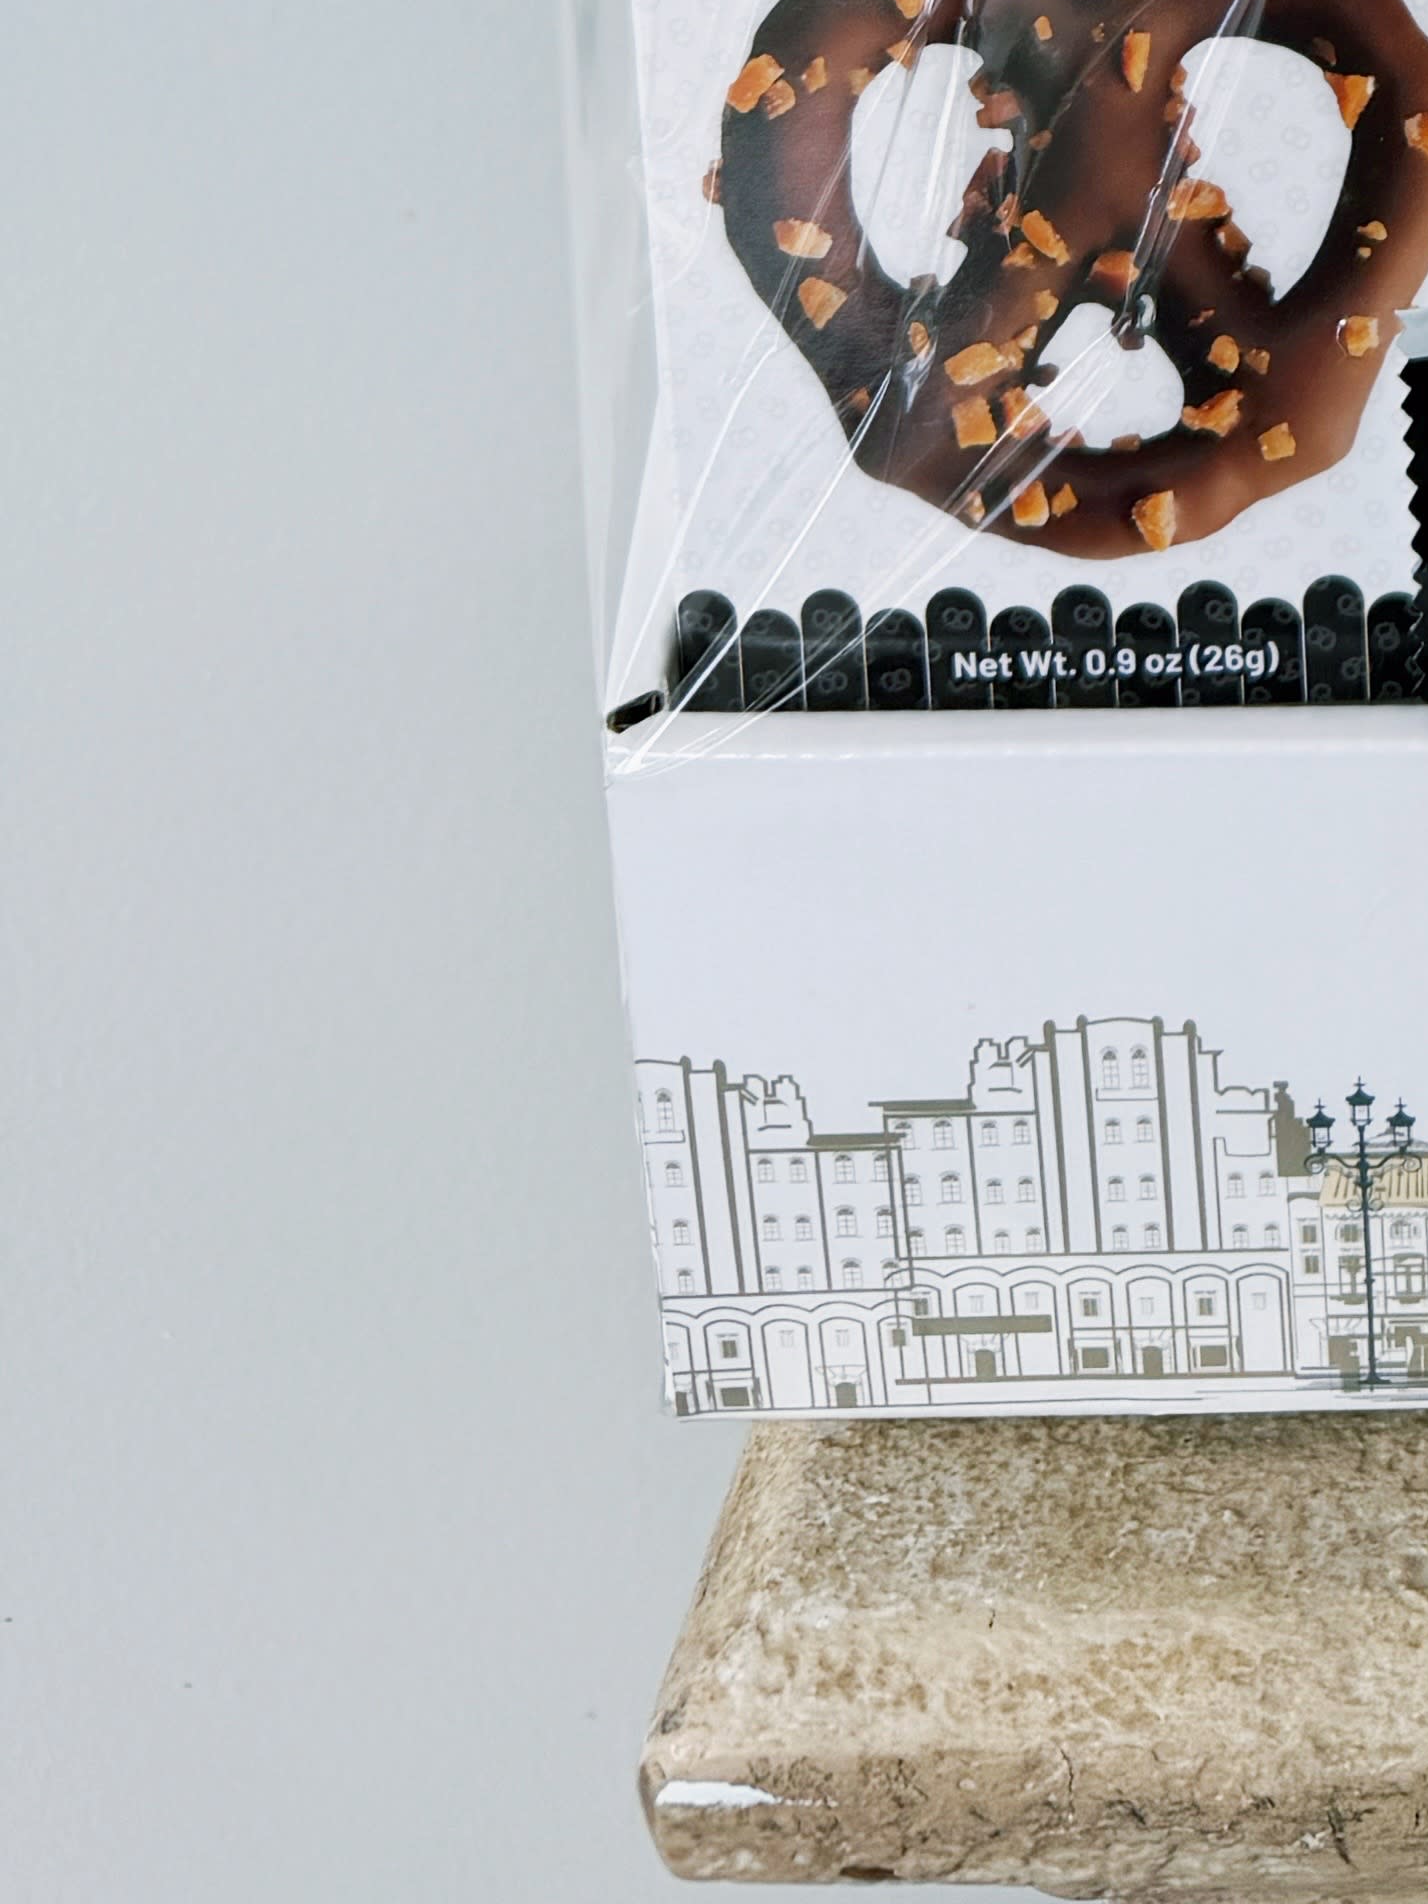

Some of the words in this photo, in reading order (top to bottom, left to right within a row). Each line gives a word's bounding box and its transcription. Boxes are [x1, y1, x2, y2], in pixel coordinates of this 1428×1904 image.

[953, 651, 1013, 680] Net
[1019, 649, 1077, 679] Wt.
[1085, 647, 1137, 676] 0.9
[1145, 653, 1183, 674] oz
[1189, 641, 1280, 677] (26g)
